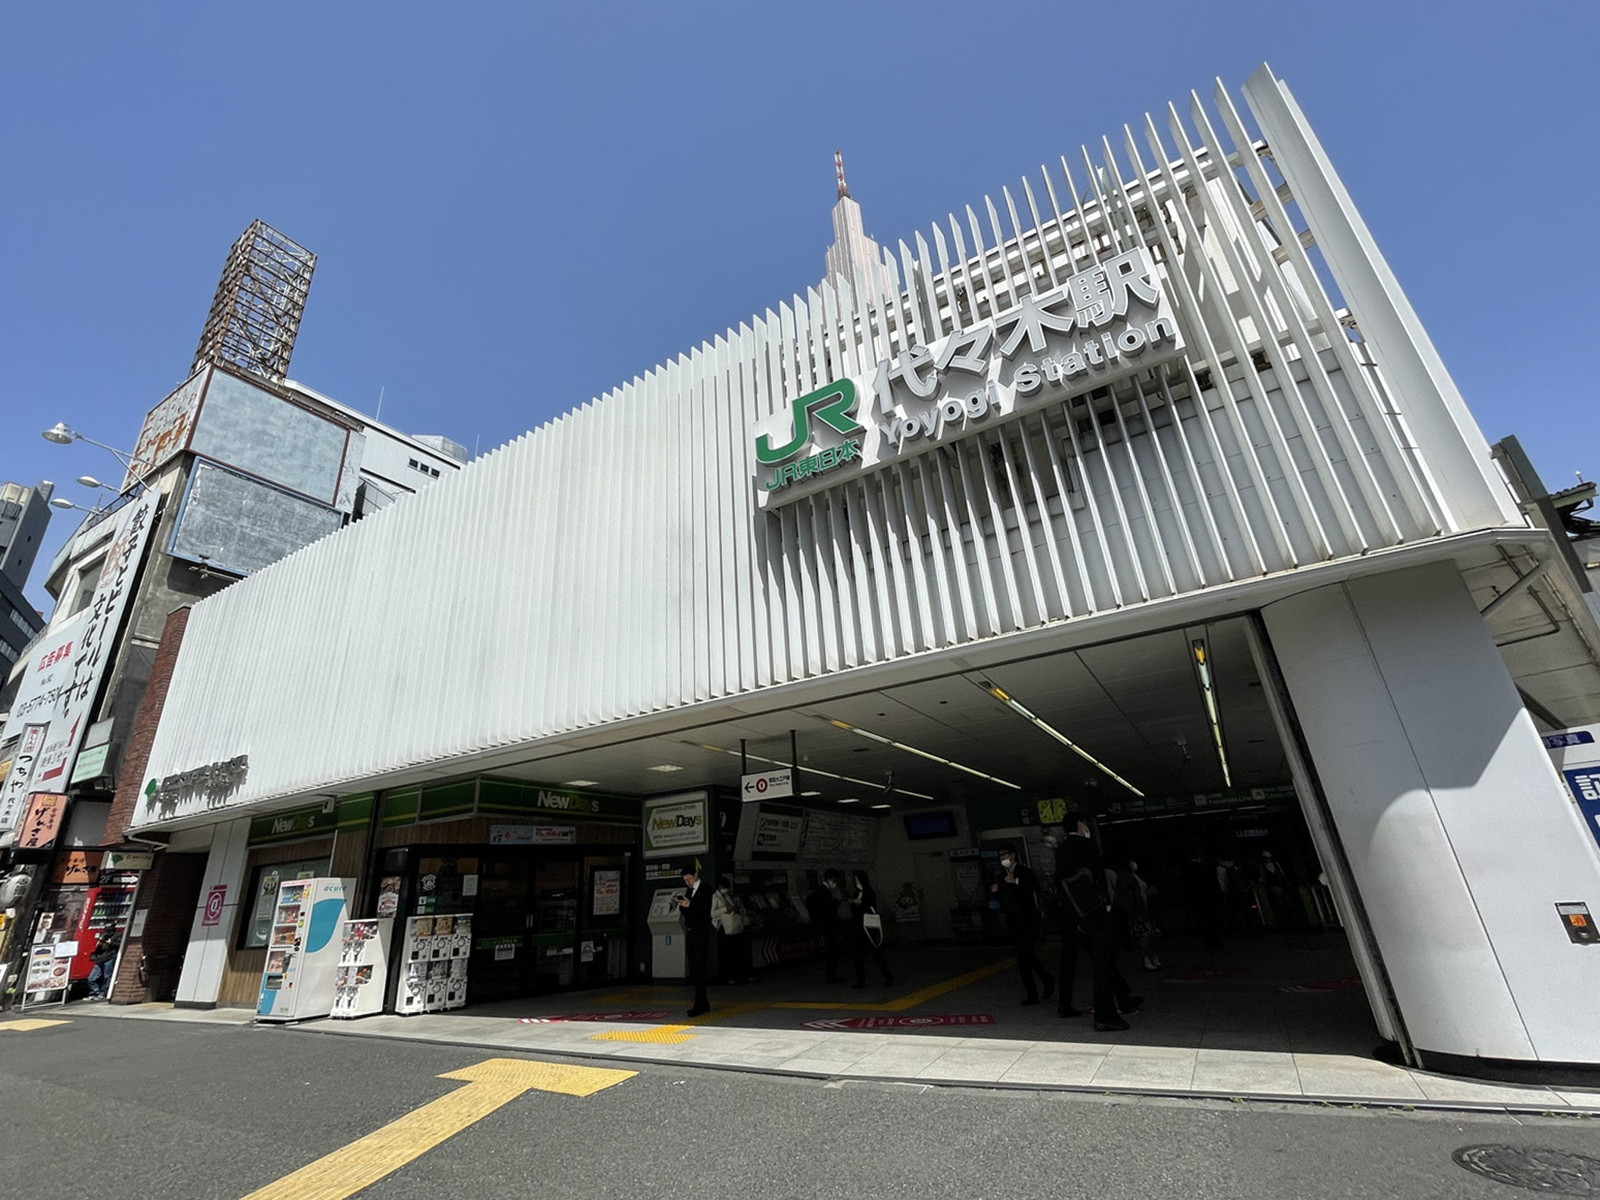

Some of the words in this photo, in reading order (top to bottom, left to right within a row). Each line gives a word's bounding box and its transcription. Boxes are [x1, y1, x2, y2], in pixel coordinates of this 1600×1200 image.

[871, 247, 1160, 417] 代々木駅
[879, 379, 1001, 446] Yoyogi
[1013, 316, 1178, 396] Station
[756, 377, 866, 465] JR
[766, 439, 862, 491] JR東日本
[37, 641, 74, 672] 広告募集
[10, 755, 33, 793] つちや
[652, 814, 702, 831] NewDays
[323, 884, 348, 892] acure
